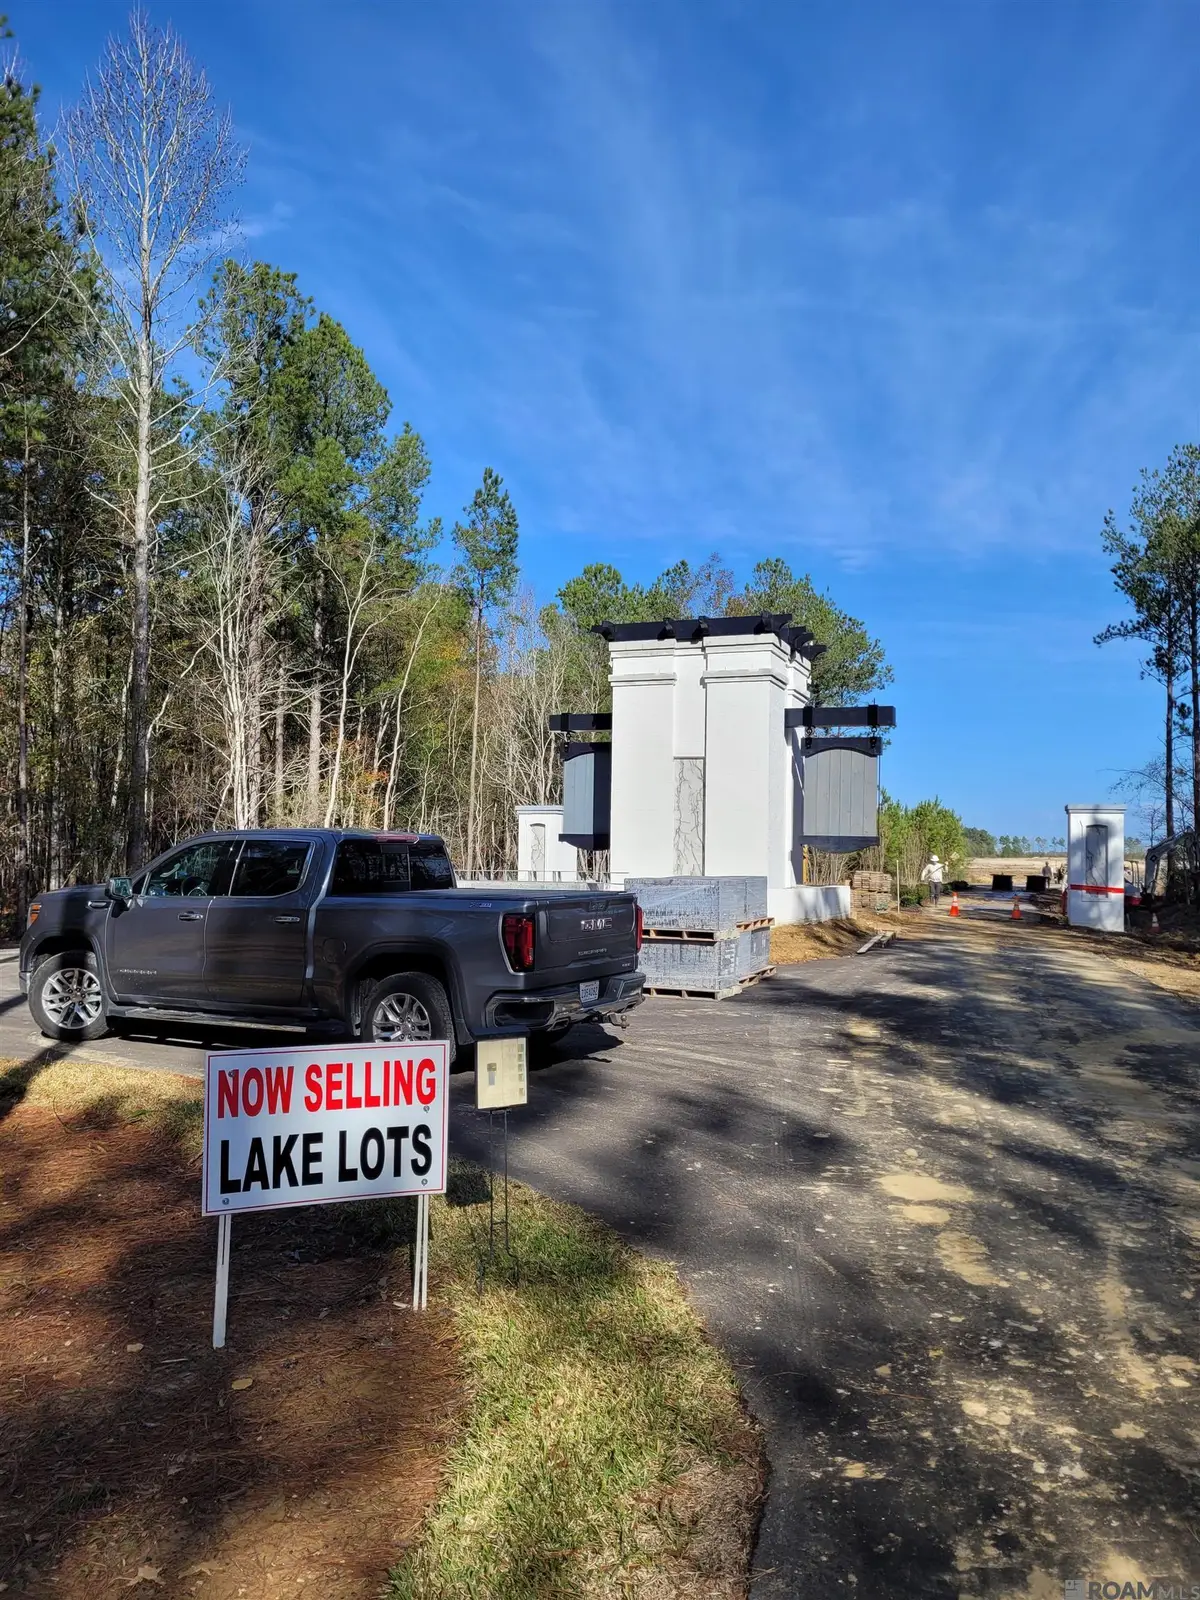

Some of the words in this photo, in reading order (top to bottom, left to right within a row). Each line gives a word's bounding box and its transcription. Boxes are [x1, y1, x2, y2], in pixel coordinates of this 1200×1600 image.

[217, 1065, 294, 1119] NOW
[304, 1058, 436, 1113] SELLING
[219, 1132, 324, 1194] LAKE
[338, 1124, 432, 1182] LOTS
